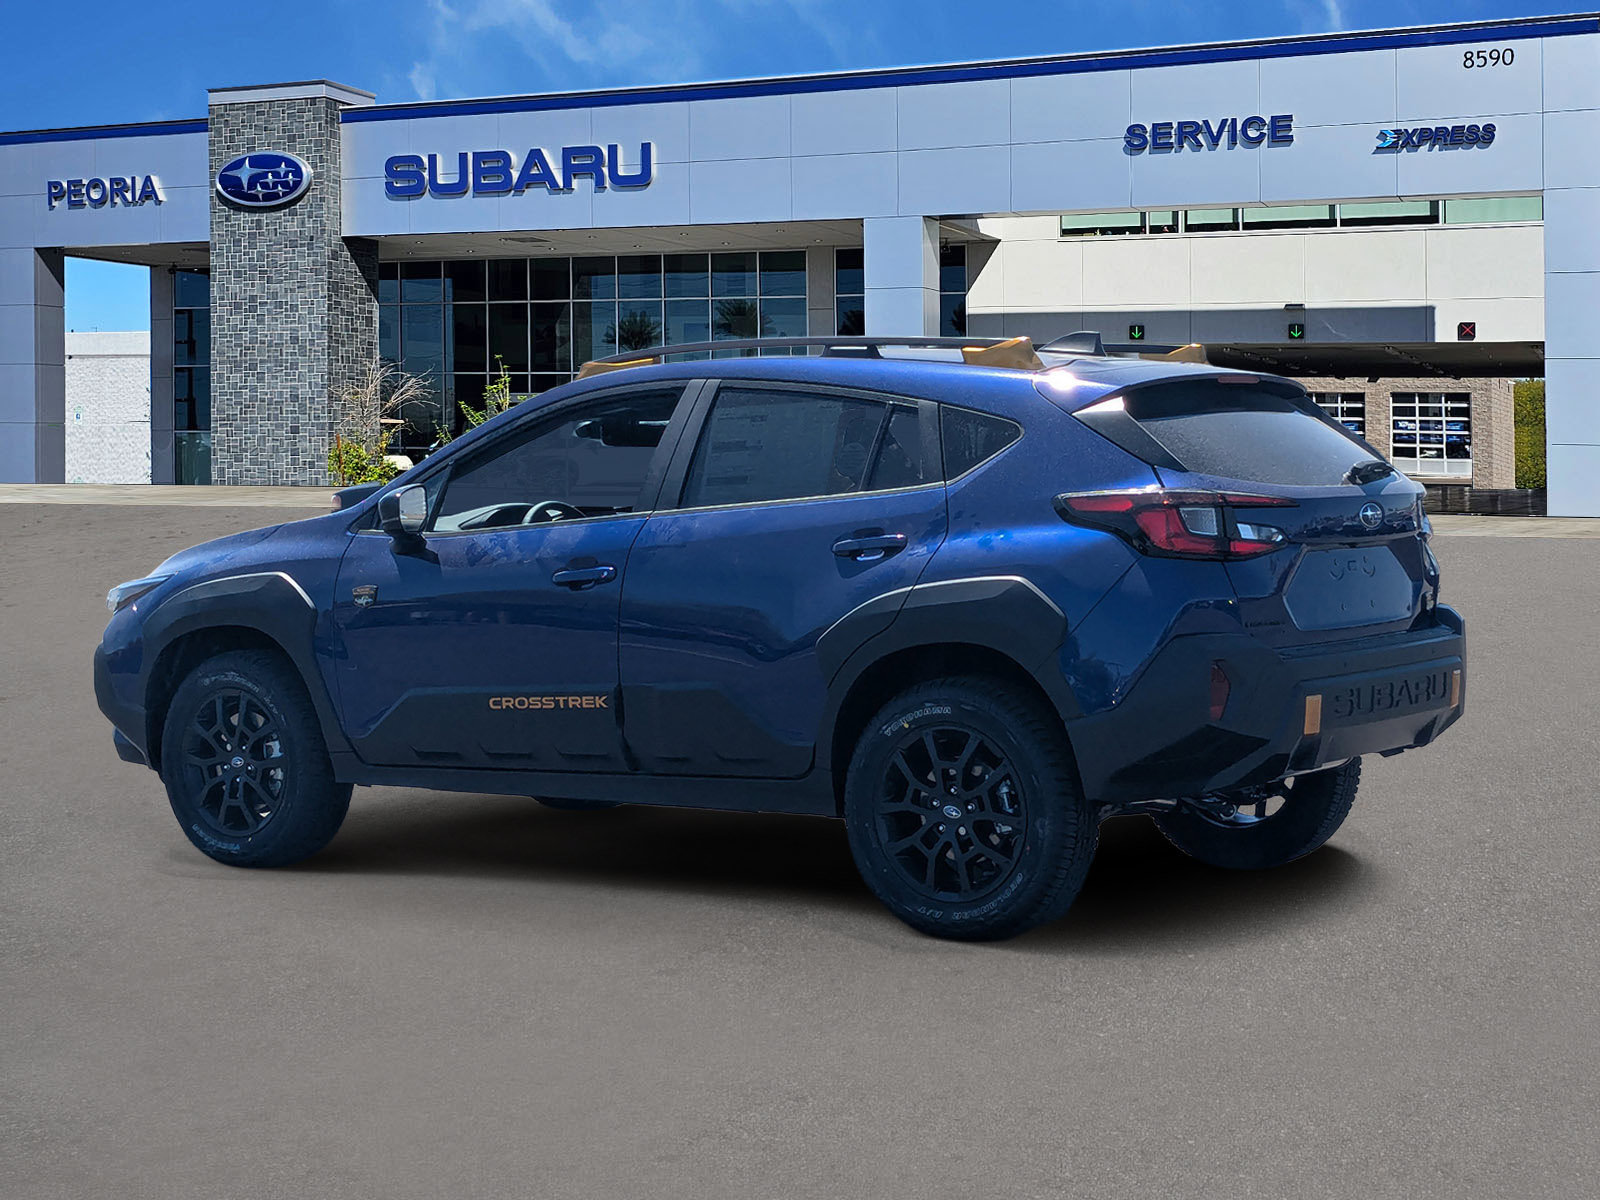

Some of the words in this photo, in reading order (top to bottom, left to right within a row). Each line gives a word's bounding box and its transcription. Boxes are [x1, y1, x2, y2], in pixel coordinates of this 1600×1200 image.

[1463, 48, 1515, 69] 8590
[1124, 114, 1294, 152] SERVICE
[1375, 123, 1497, 149] EXPRESS
[384, 141, 652, 198] SUBARU
[47, 175, 162, 209] PEORIA
[489, 695, 608, 710] CROSSTREK
[1334, 672, 1447, 718] SUBARU
